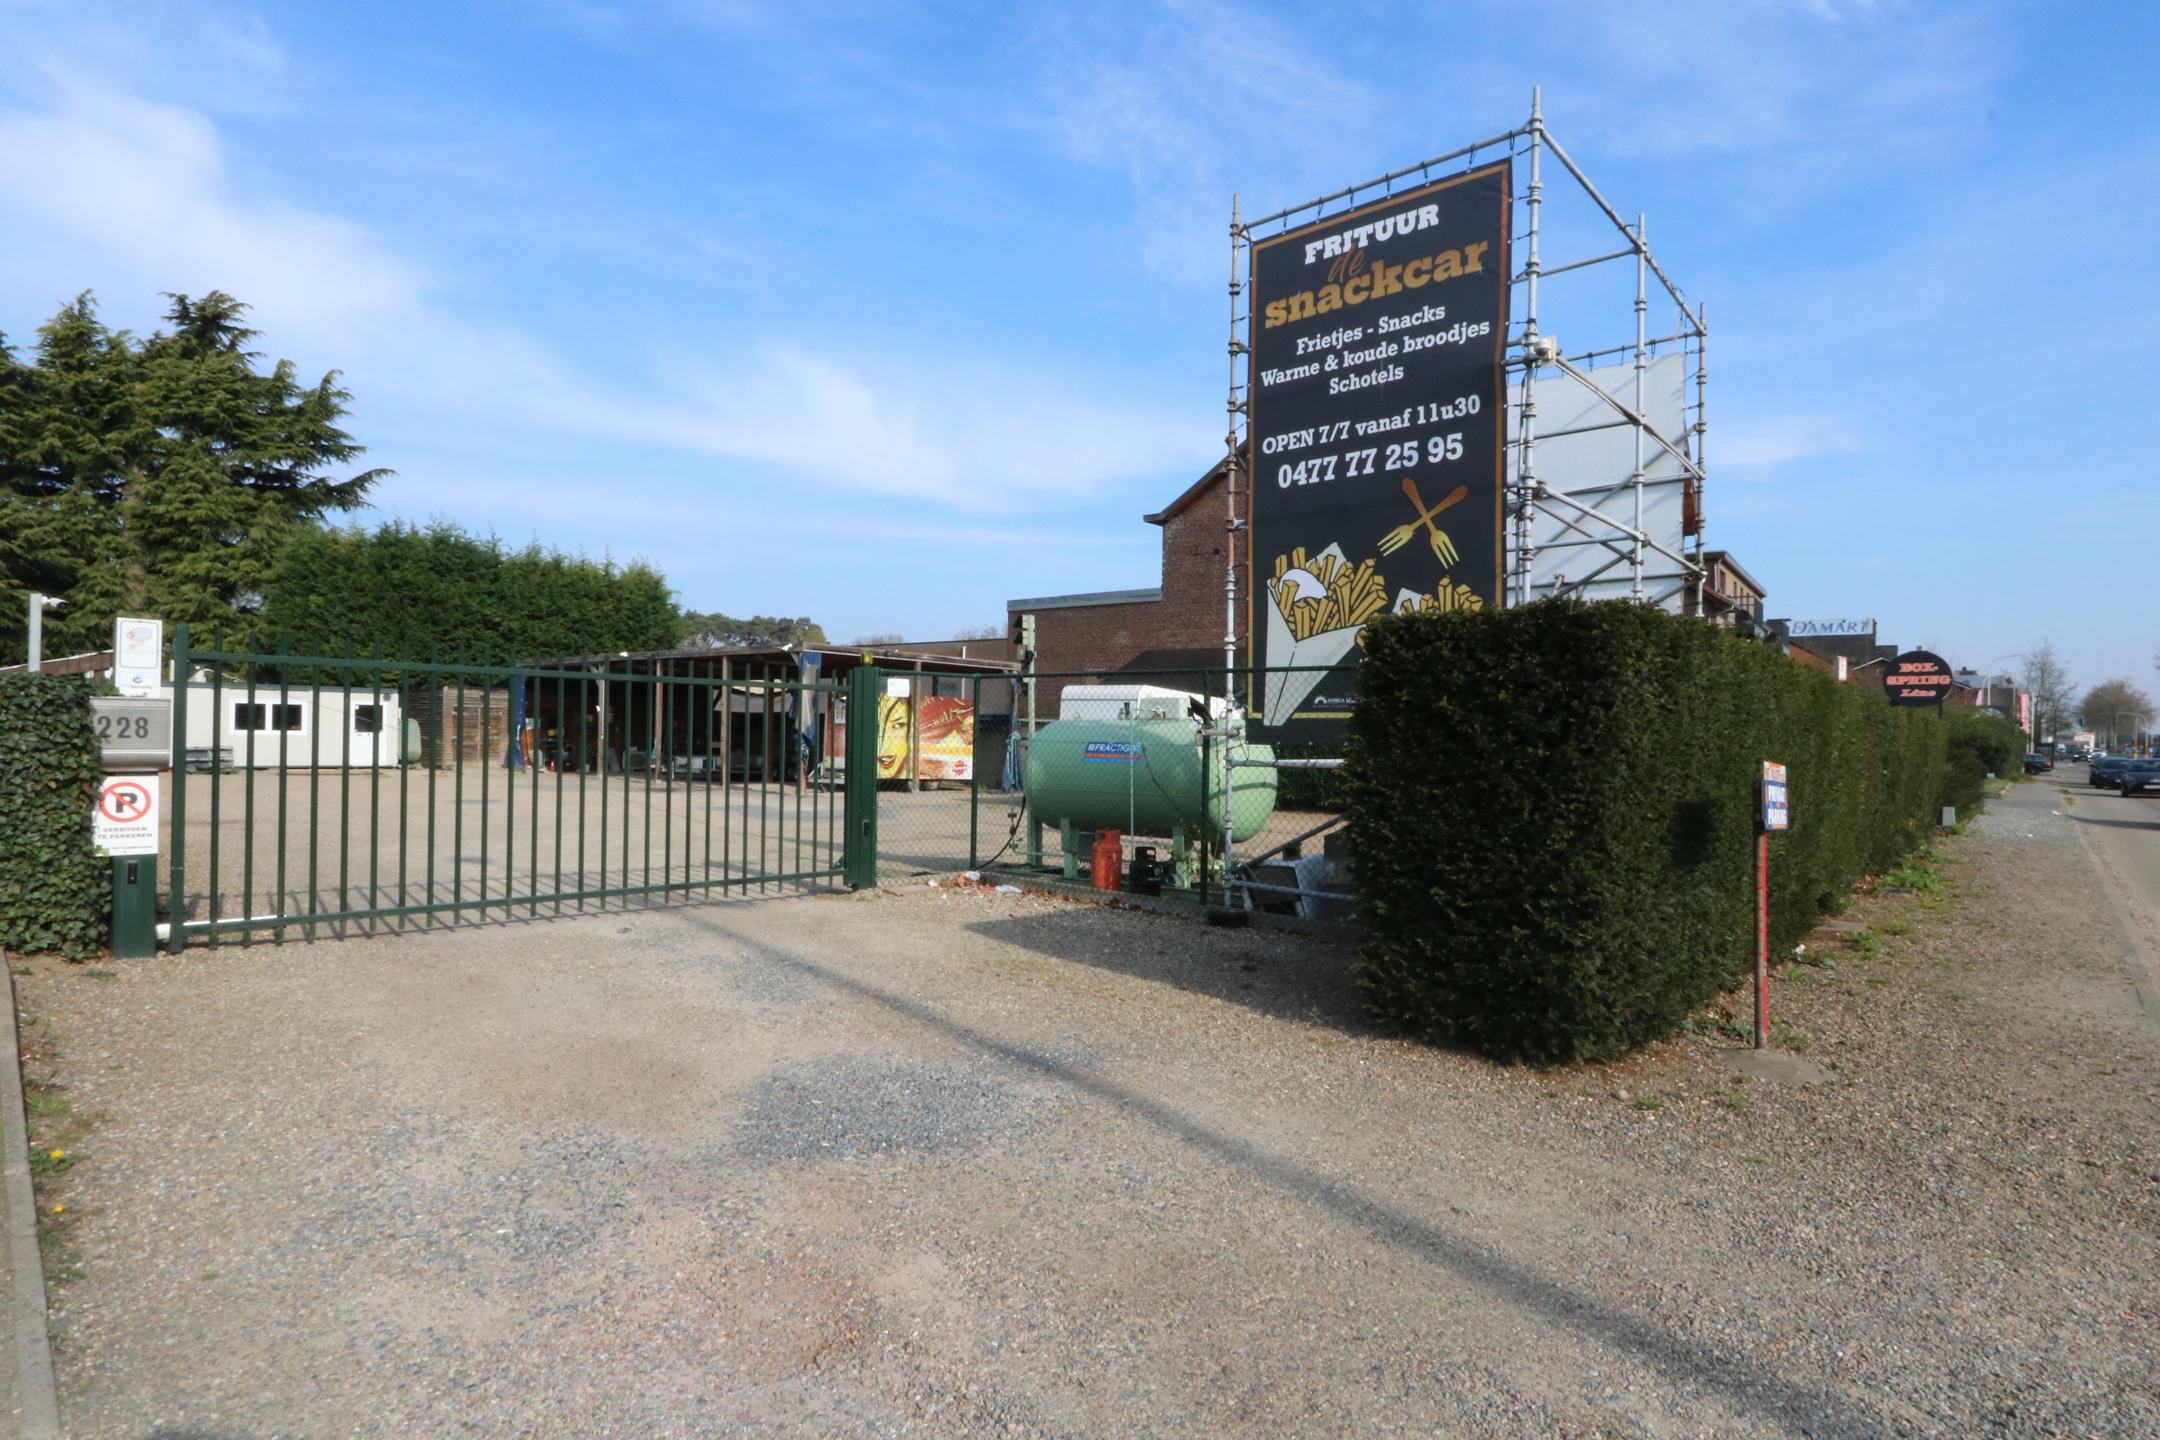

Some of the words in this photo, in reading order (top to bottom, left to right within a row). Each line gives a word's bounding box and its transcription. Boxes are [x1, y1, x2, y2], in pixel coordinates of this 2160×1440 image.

[1304, 203, 1440, 265] FRITUUR
[1264, 240, 1489, 329] snackcar
[1296, 324, 1363, 356] Frietjes
[1378, 304, 1446, 335] Snacks
[1261, 361, 1320, 387] Warme
[1324, 355, 1340, 372] &
[1342, 340, 1398, 368] koude
[1403, 320, 1490, 353] broodjes
[1329, 364, 1404, 395] Schotels
[1262, 431, 1314, 455] OPEN
[1319, 421, 1350, 445] 7/7
[1355, 408, 1412, 438] vanaf
[1417, 394, 1481, 426] 11u30
[1278, 455, 1336, 489] 0477
[1345, 447, 1377, 478] 77
[1385, 440, 1419, 471] 25
[1427, 433, 1464, 464] 95
[1791, 621, 1869, 634] DAMART
[1886, 675, 1951, 685] SPRING
[1898, 662, 1939, 672] BOX-
[97, 716, 148, 738] 228
[1768, 808, 1788, 825] PARKING
